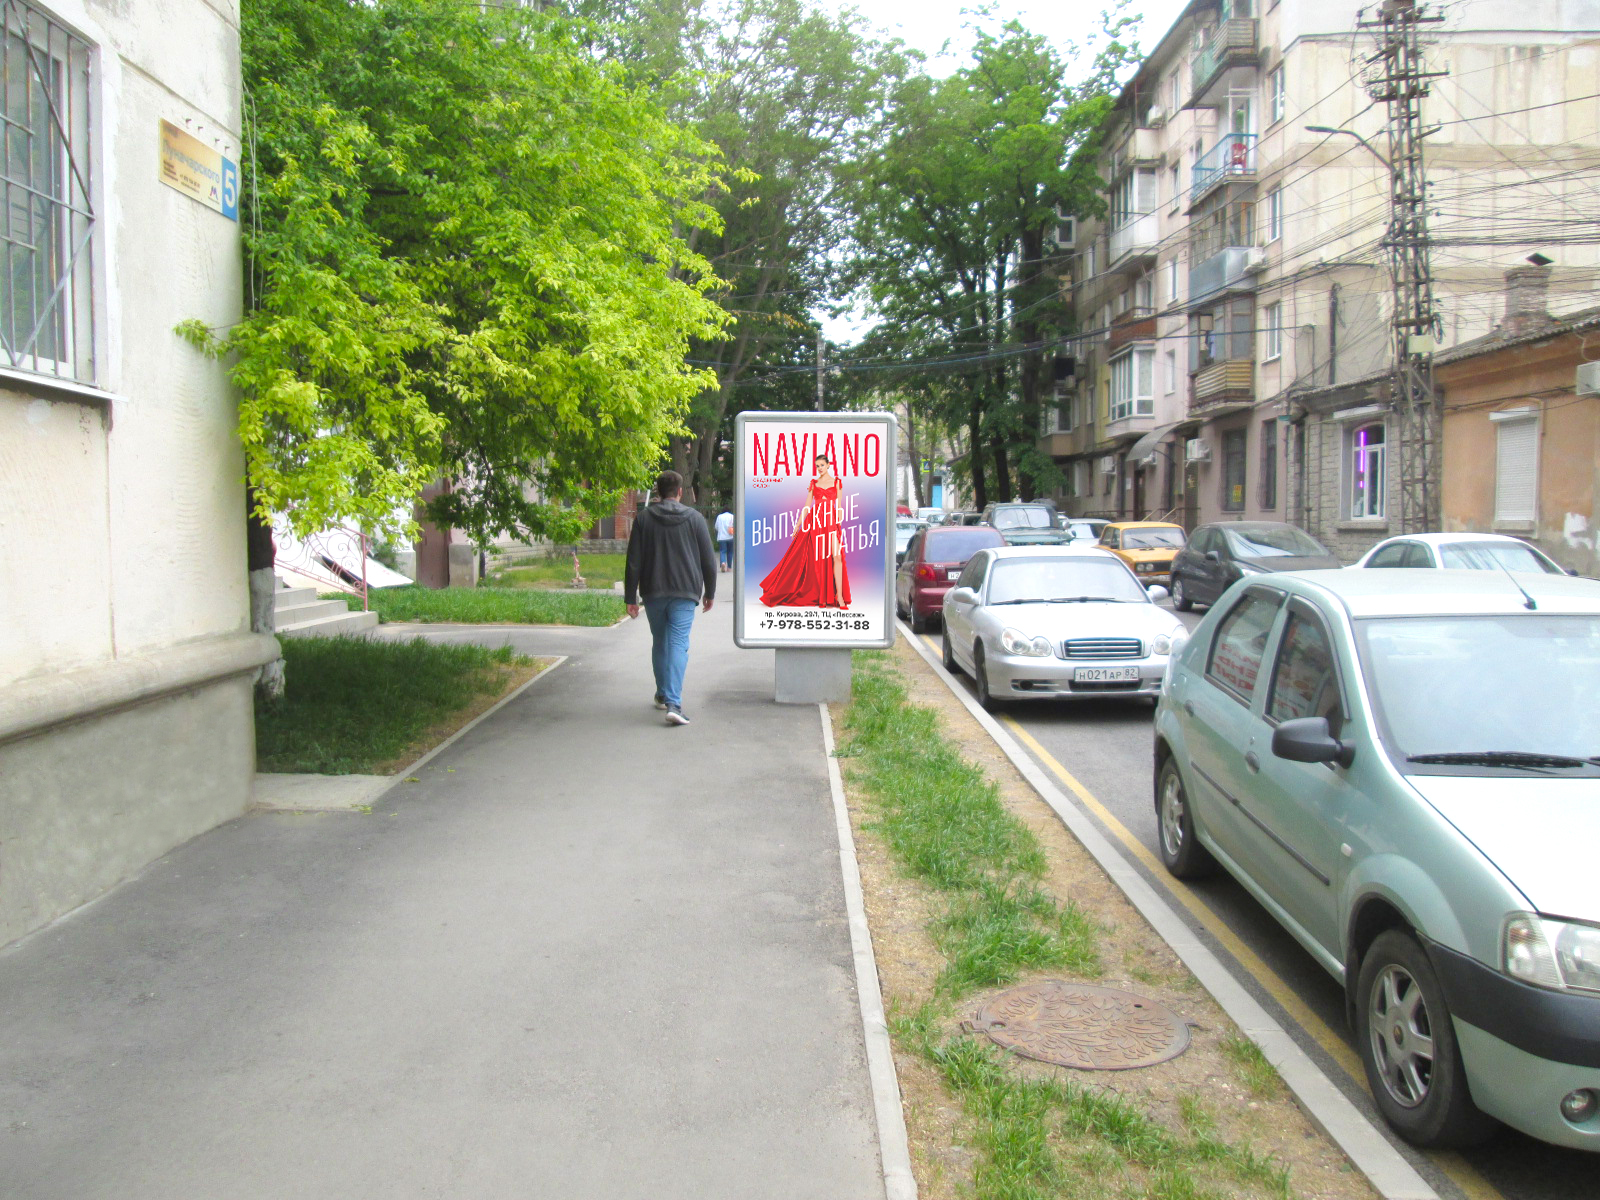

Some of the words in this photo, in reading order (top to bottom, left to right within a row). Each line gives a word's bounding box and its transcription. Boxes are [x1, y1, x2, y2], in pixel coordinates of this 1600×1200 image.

[225, 169, 236, 208] 5
[753, 432, 881, 477] NAVIANO
[752, 492, 860, 547] ВЫПУСКНЫЕ
[815, 519, 880, 562] ПЛАТЬЯ
[759, 619, 870, 630] +7-978-552-31-88
